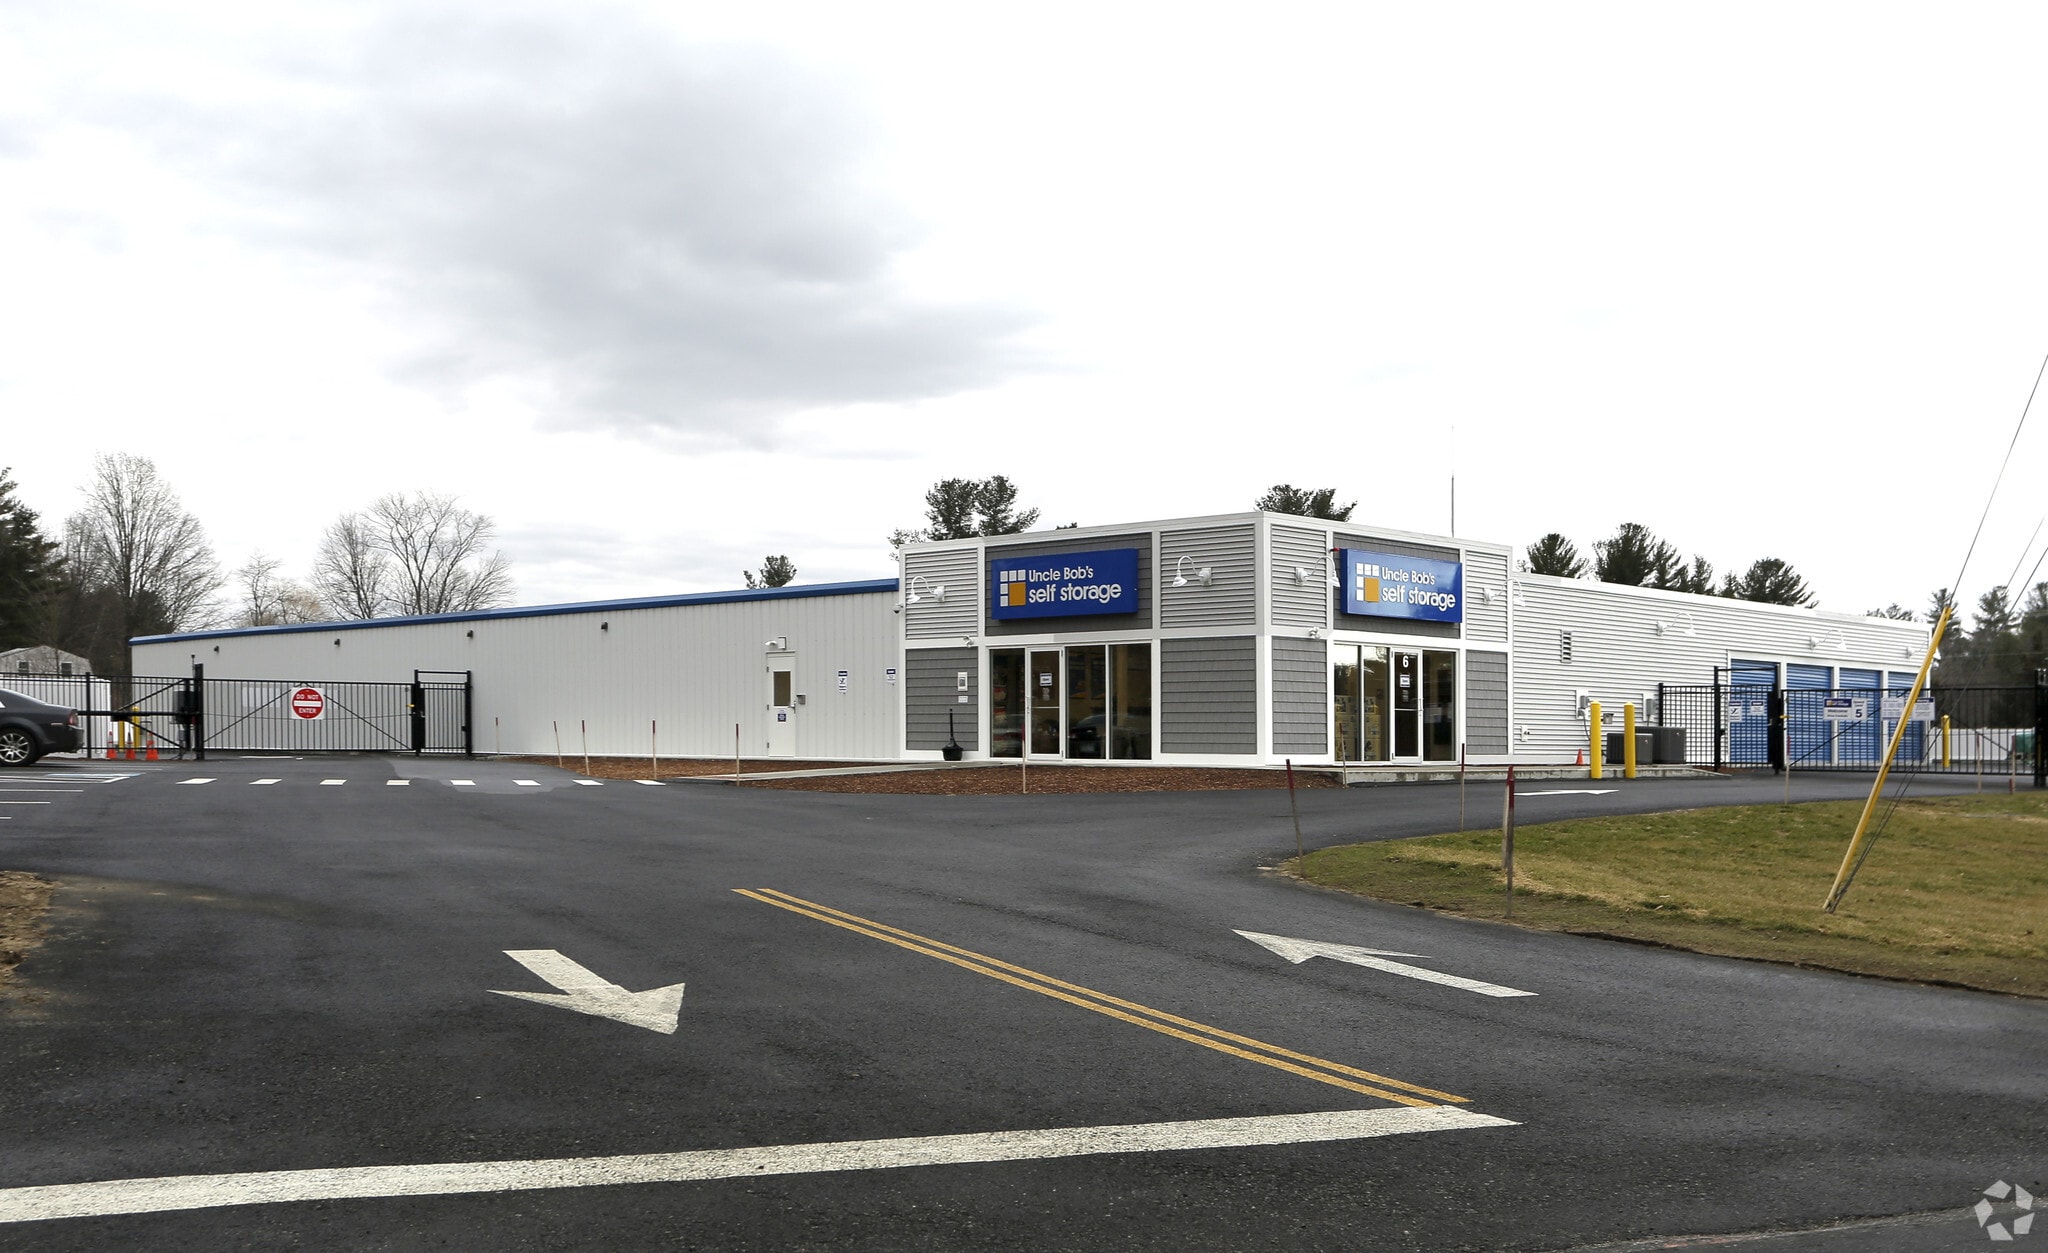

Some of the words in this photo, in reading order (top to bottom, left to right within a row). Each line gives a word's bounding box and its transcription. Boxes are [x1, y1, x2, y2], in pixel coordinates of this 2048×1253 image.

[1028, 568, 1061, 582] Uncle
[1063, 565, 1094, 580] Bob's
[1381, 566, 1409, 583] Uncle
[1411, 570, 1436, 585] Bob's
[1028, 583, 1057, 604] self
[1060, 582, 1122, 604] storage
[1382, 584, 1406, 603] self
[1408, 586, 1456, 612] storage
[1402, 655, 1409, 668] 6
[1855, 708, 1863, 718] 5
